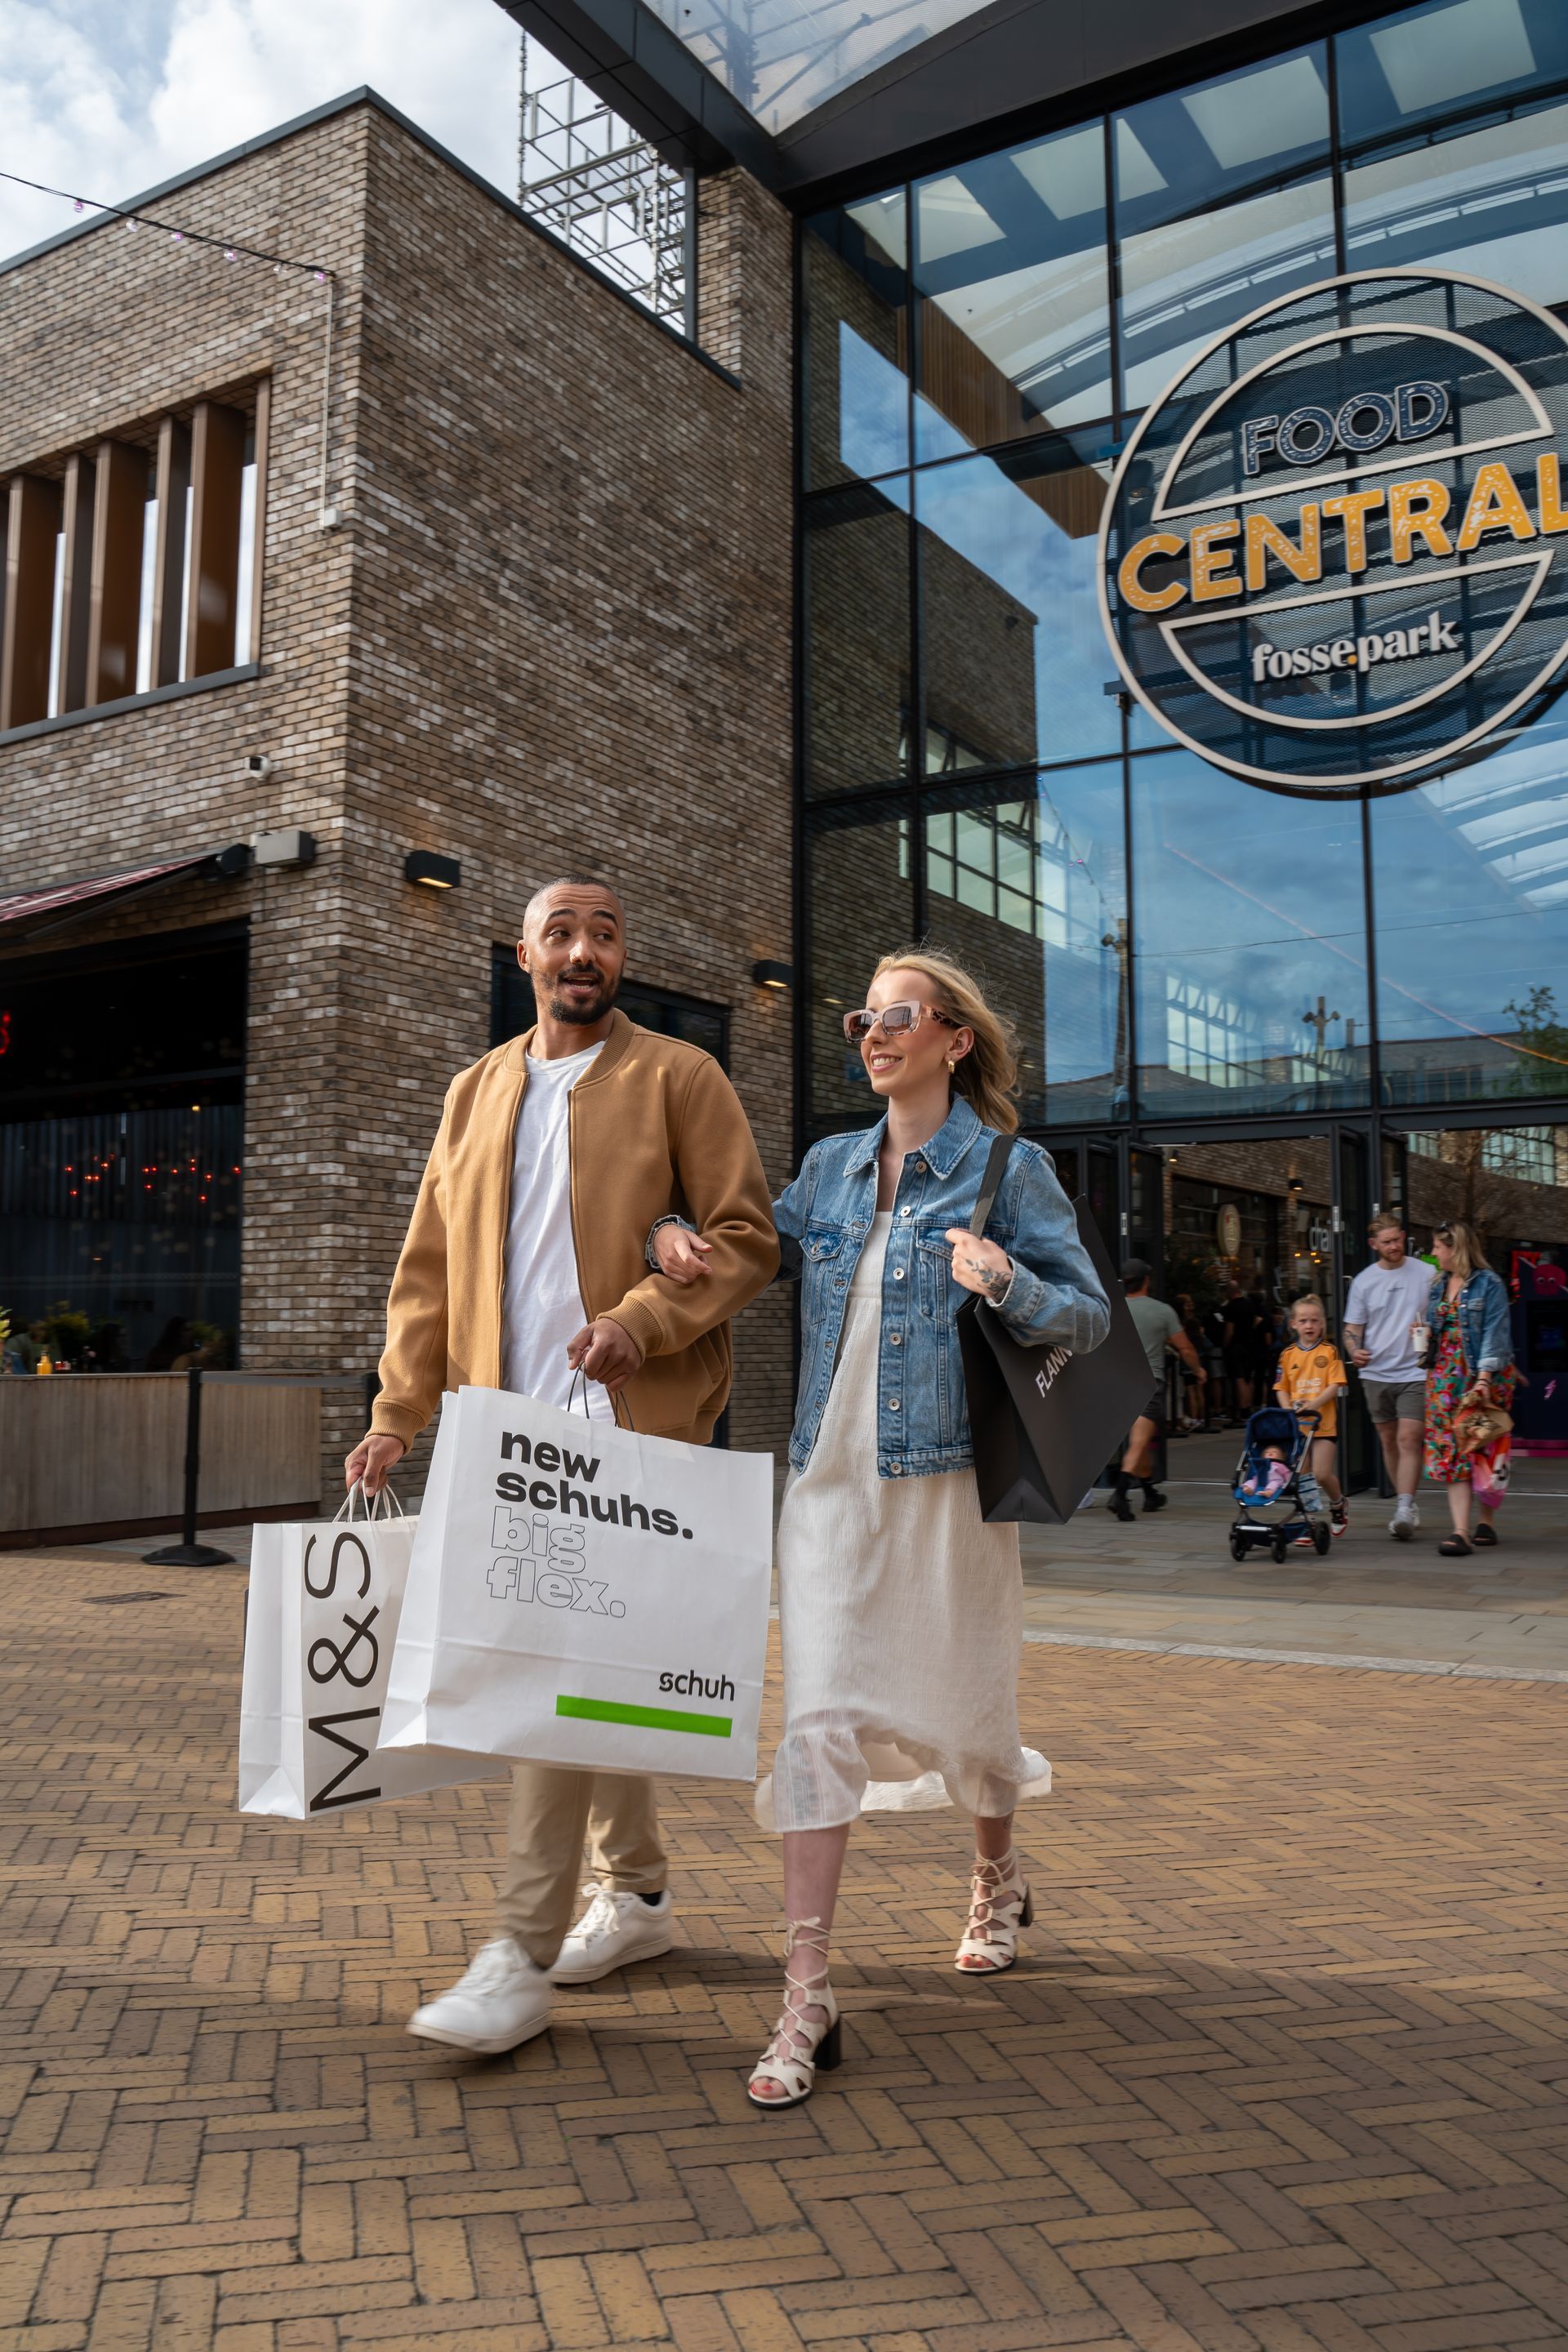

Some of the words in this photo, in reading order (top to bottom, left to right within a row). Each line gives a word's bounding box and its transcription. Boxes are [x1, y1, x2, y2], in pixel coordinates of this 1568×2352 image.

[1242, 381, 1449, 475] FOOD
[1118, 452, 1568, 612] CENTRAL
[500, 1431, 600, 1482] new
[496, 1472, 693, 1539] schuhs.
[491, 1506, 586, 1575] big
[487, 1556, 626, 1619] flex.
[305, 1532, 381, 1812] M&S
[659, 1670, 735, 1701] schuh
